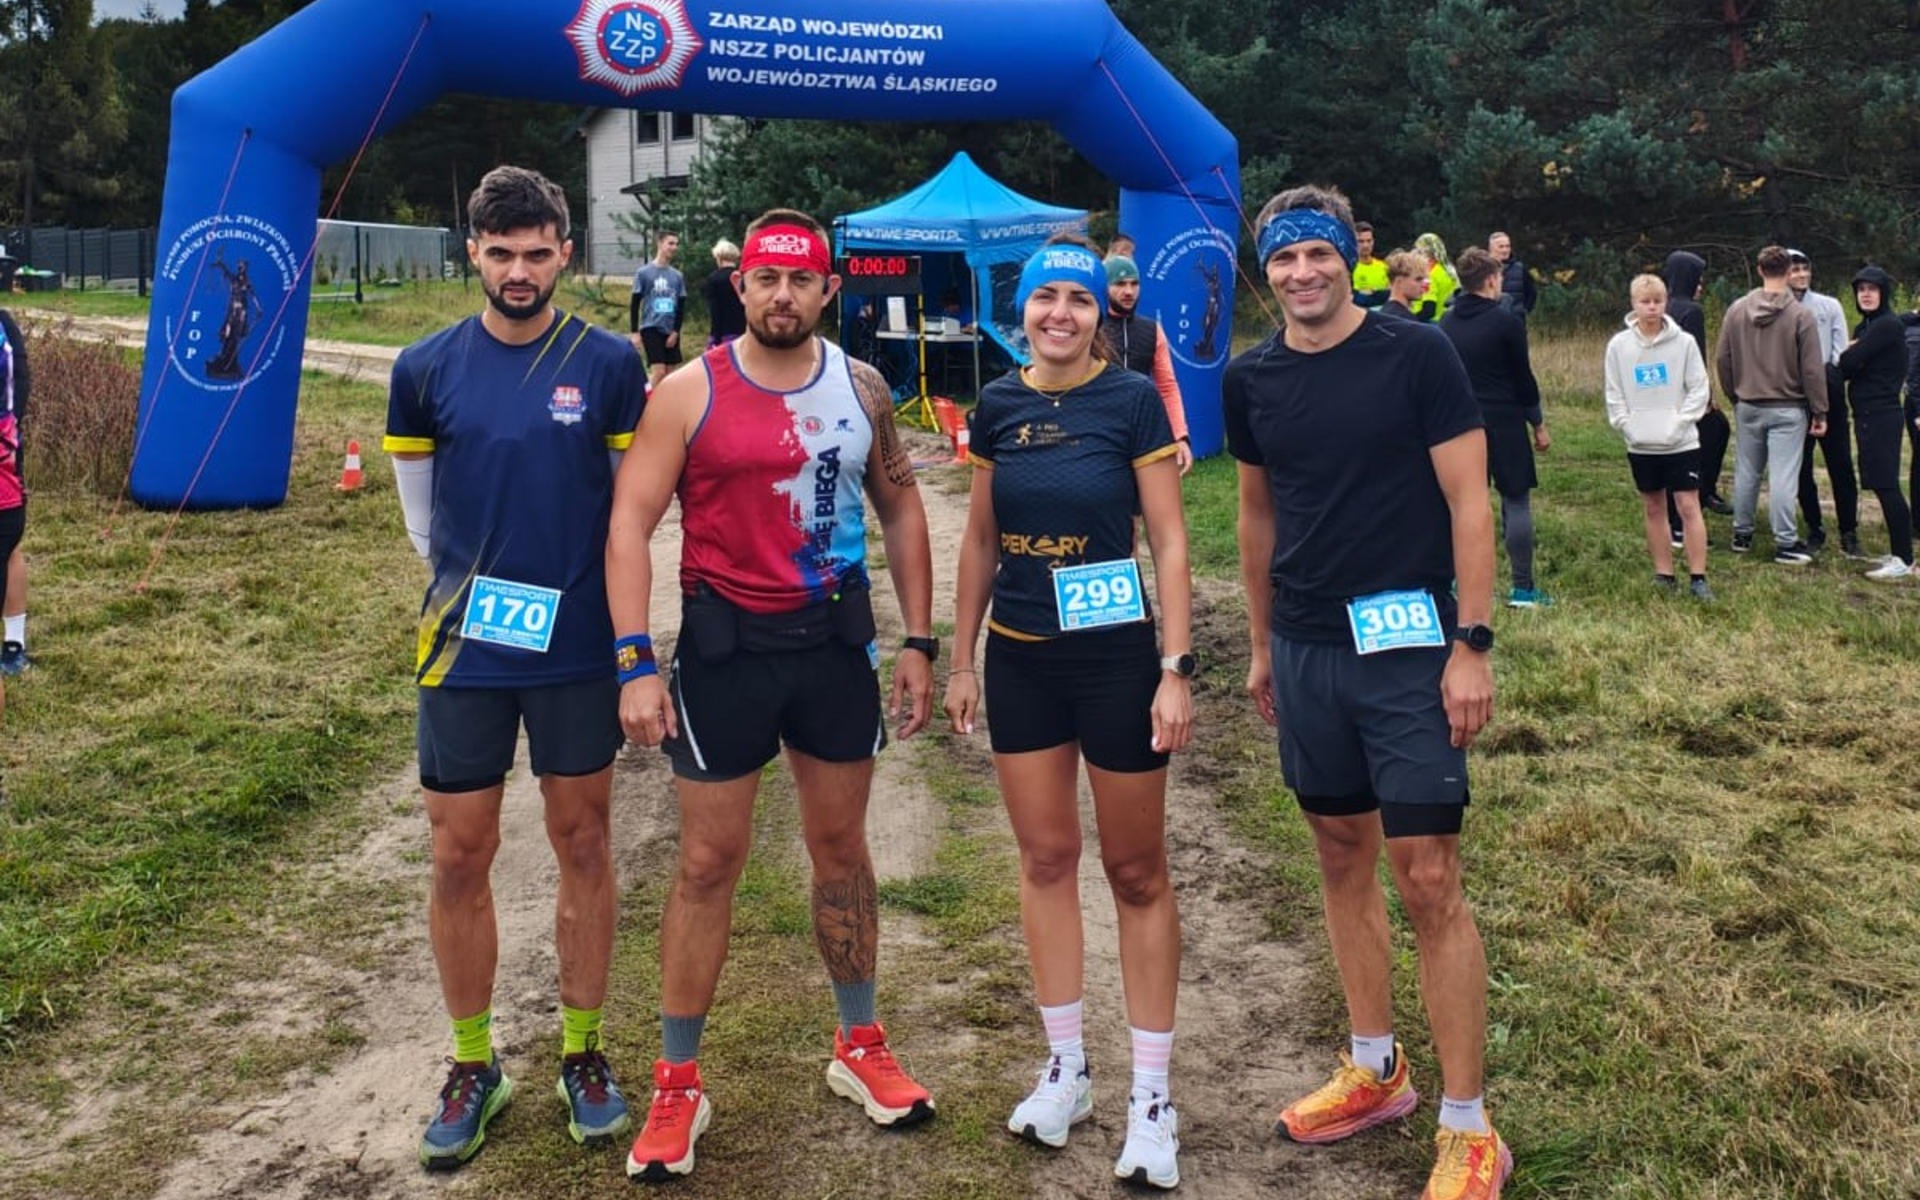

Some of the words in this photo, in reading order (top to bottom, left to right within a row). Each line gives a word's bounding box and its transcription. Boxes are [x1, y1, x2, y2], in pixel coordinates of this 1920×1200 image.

[709, 12, 796, 36] ZARZĄD
[802, 18, 943, 40] WOJEWÓDZKI
[709, 39, 768, 58] NSZZ
[774, 43, 925, 66] POLICJANTÓW
[707, 66, 877, 90] WOJEWÓDZTWA
[883, 73, 997, 94] ŚLĄSKIEGO
[205, 229, 267, 247] OCHRONY
[850, 257, 907, 275] 0:00:00
[814, 446, 841, 518] BIEGA
[1064, 576, 1133, 611] 299
[478, 594, 547, 632] 170
[1359, 602, 1433, 635] 308
